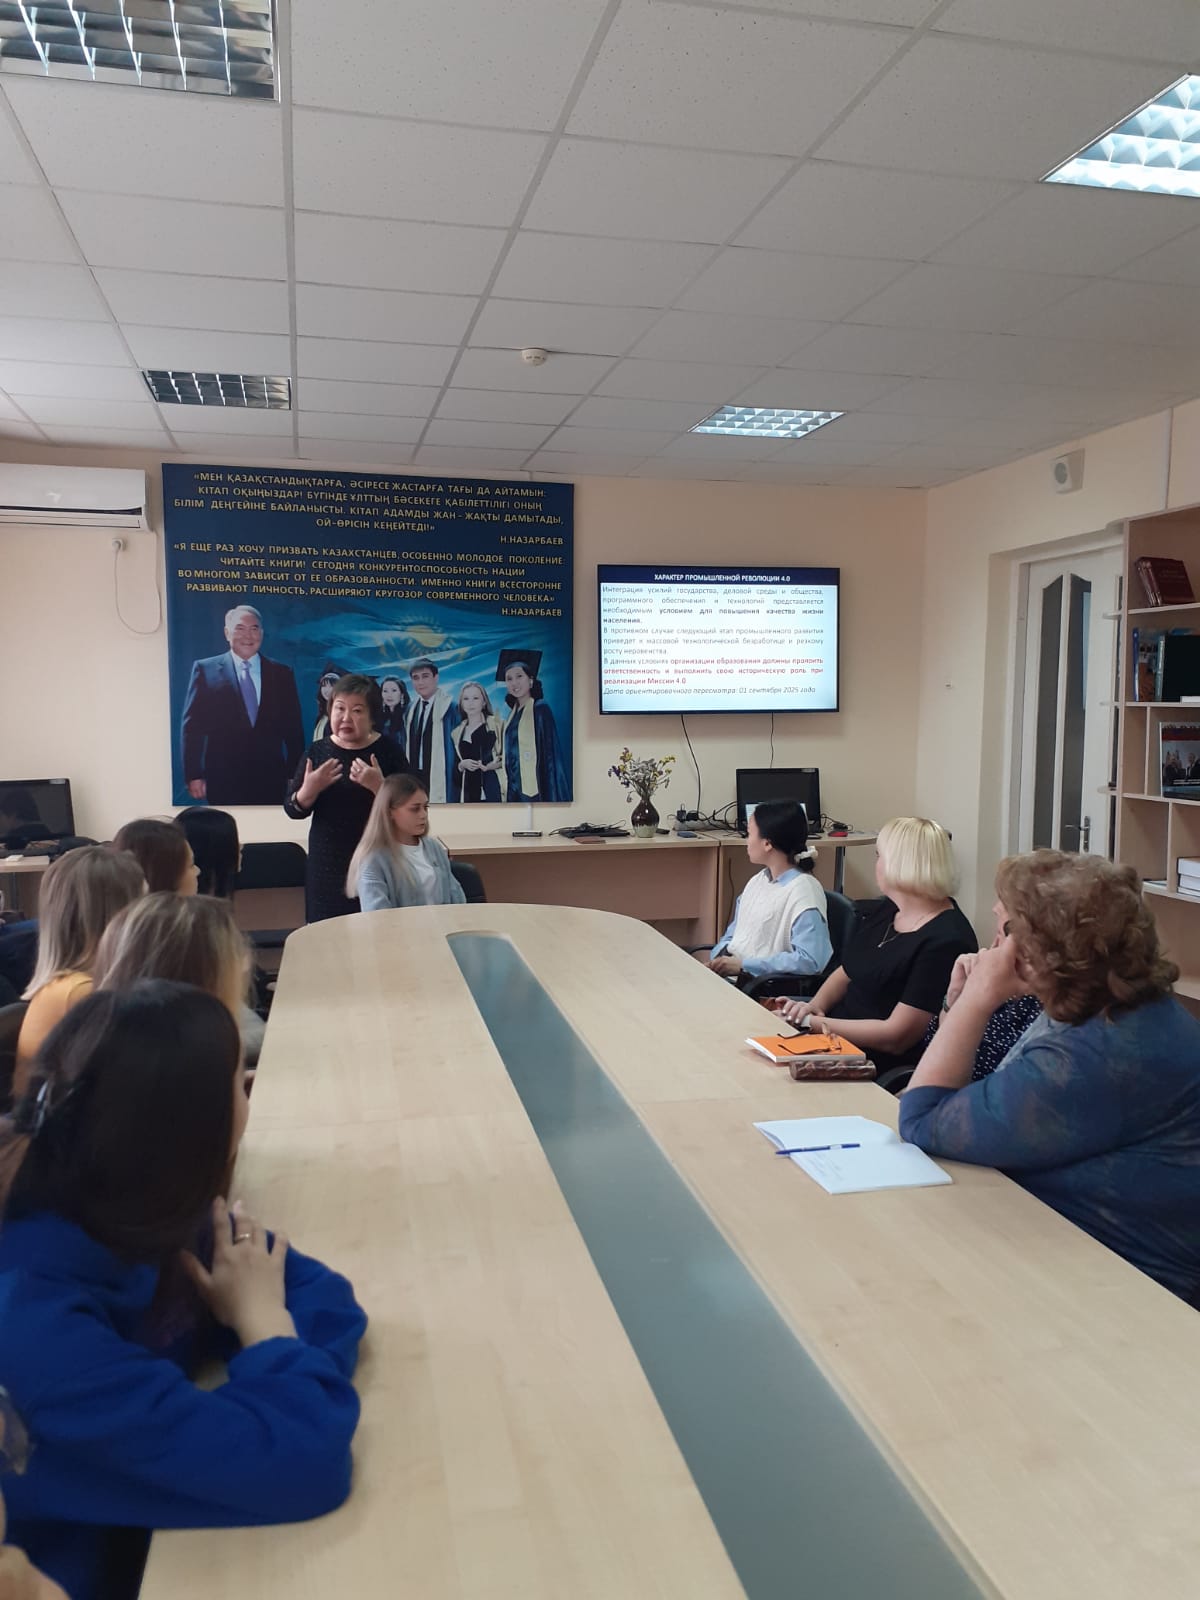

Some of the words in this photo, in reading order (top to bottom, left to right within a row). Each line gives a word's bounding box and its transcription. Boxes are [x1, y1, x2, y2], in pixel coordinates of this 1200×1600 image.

[194, 473, 222, 481] «МЕН
[350, 481, 389, 489] ӘСІРЕСЕ
[392, 483, 443, 492] ЖАСТАРҒА
[448, 486, 472, 494] ТАҒЫ
[477, 487, 491, 495] ДА
[199, 487, 228, 495] КІТАП
[307, 492, 348, 501] БҮГІНДЕ
[351, 494, 390, 504] ҰЛТТЫҢ
[394, 496, 440, 506] БӘСЕКЕГЕ
[445, 499, 509, 509] ҚАБІЛЕТТІЛІГІ
[513, 502, 542, 511] ОНЫҢ
[175, 499, 204, 508] БІЛІМ
[211, 499, 266, 510] ДЕҢГЕЙІНЕ
[350, 507, 378, 516] КІТАП
[384, 509, 429, 518] АДАМДЫ
[465, 512, 500, 521] ЖАҚТЫ
[317, 518, 369, 528] ОЙ-ӨРІСІН
[501, 536, 563, 545] Н.НАЗАРБАЕВ
[191, 543, 212, 551] ЕЩЕ
[238, 545, 264, 553] ХОЧУ
[269, 546, 318, 555] ПРИЗВАТЬ
[402, 551, 452, 561] ОСОБЕННО
[457, 553, 503, 563] МОЛОДОЕ
[221, 556, 265, 567] ЧИТАЙТЕ
[270, 559, 305, 568] КНИГИ!
[312, 561, 355, 570] СЕГОДНЯ
[359, 563, 488, 575] КОНКУРЕНТОСПОСОБНОСТЬ
[493, 567, 525, 577] НАЦИИ
[194, 570, 240, 579] МНОГОМ
[244, 572, 288, 581] ЗАВИСИТ
[311, 574, 320, 582] ЕЕ
[422, 578, 461, 587] ИМЕННО
[465, 580, 495, 588] КНИГИ
[500, 581, 561, 590] ВСЕСТОРОННЕ
[187, 584, 247, 592] РАЗВИВАЮТ
[310, 588, 371, 597] РАСШИРЯЮТ
[375, 590, 422, 598] КРУГОЗОР
[427, 592, 500, 601] СОВРЕМЕННОГО
[502, 608, 561, 616] Н.НАЗАРБАЕВ
